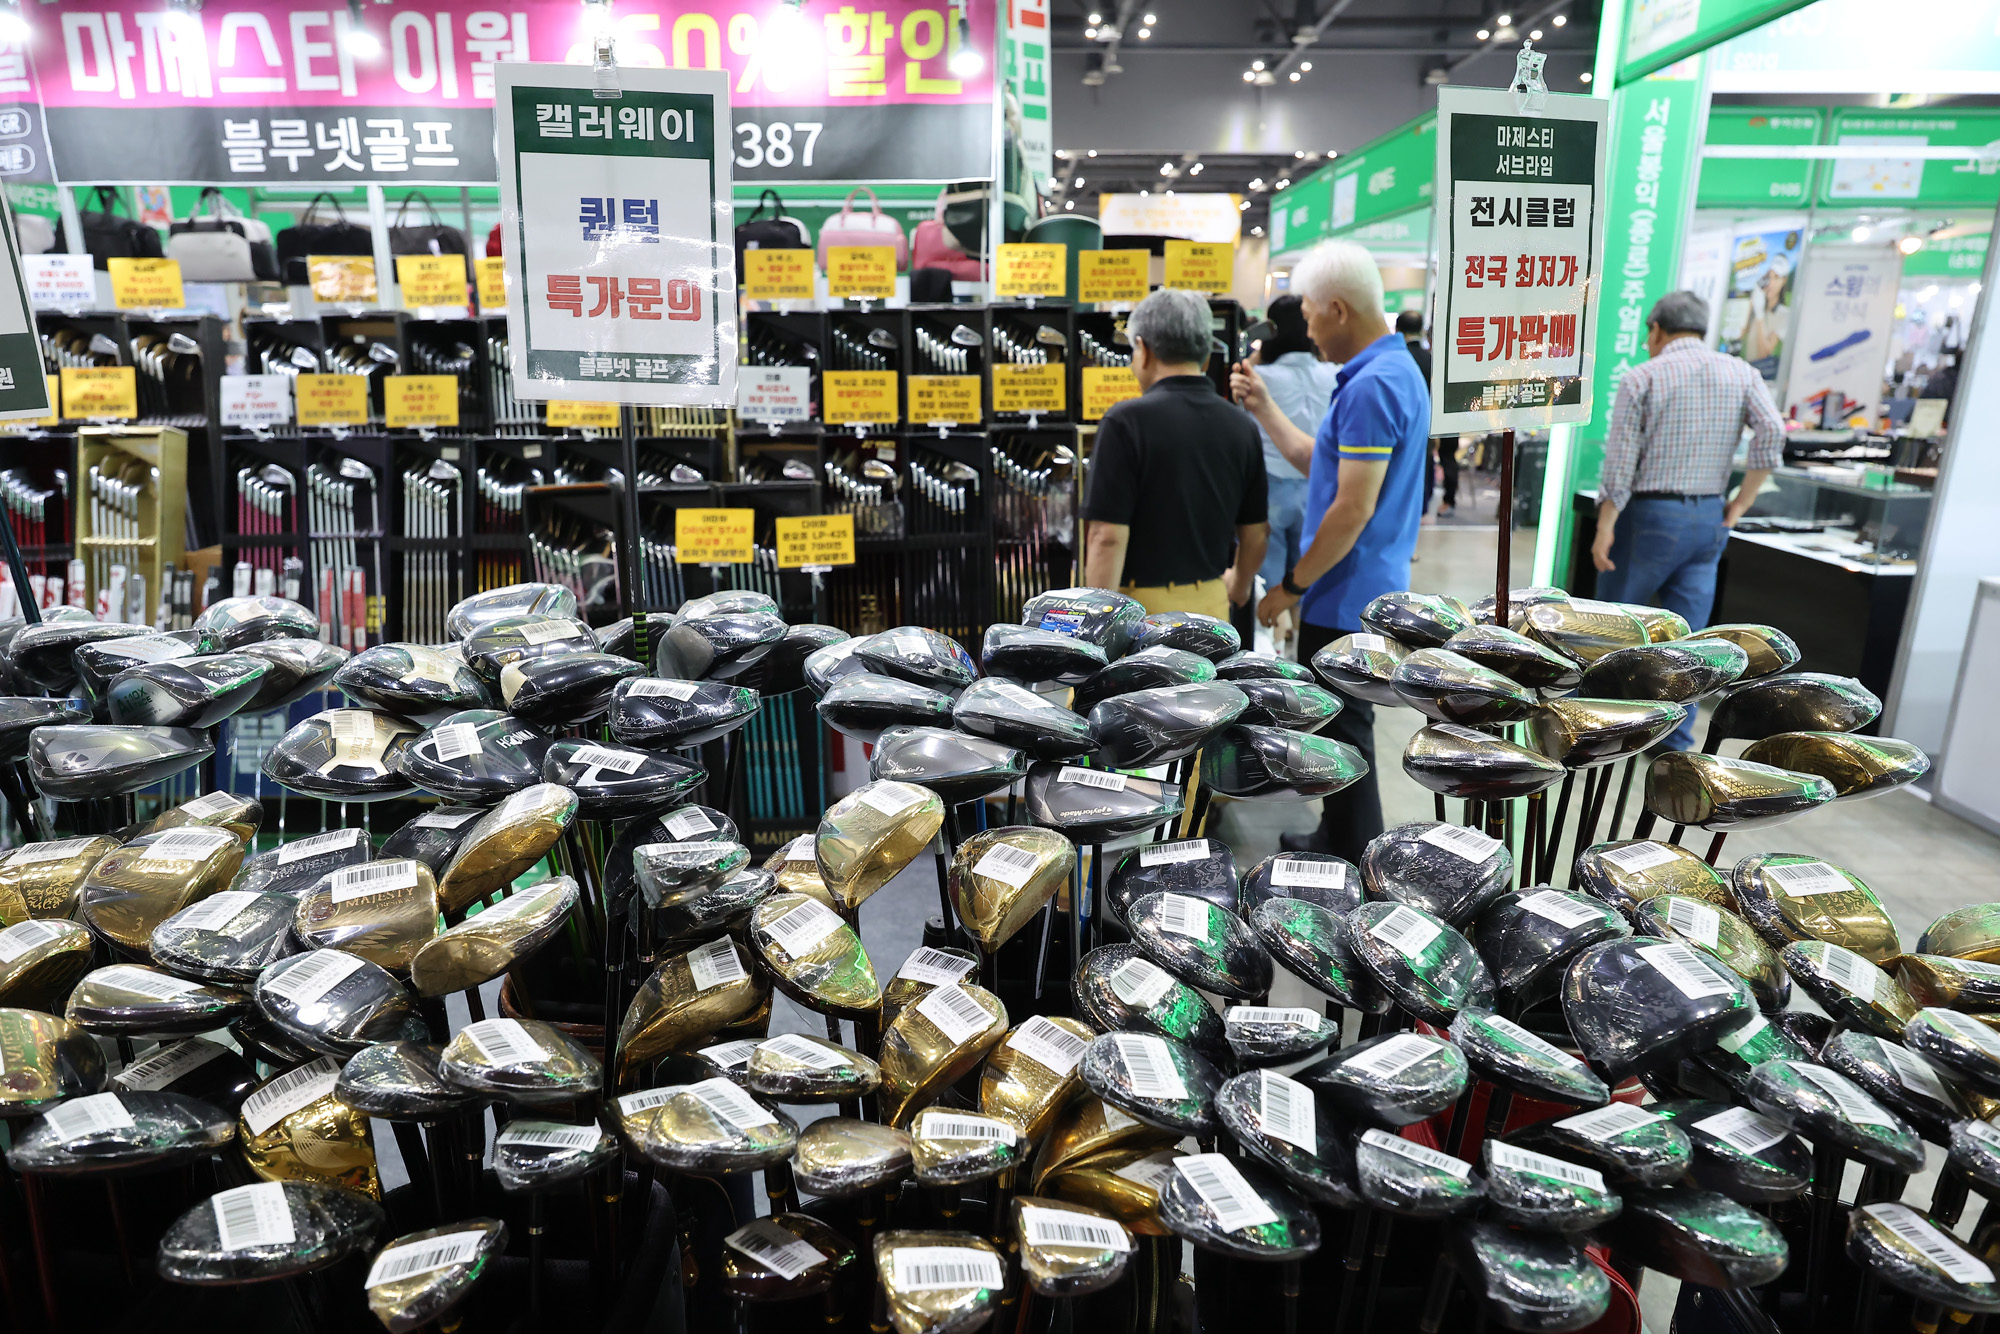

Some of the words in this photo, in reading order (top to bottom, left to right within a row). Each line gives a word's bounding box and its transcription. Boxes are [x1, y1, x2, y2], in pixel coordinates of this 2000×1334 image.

[390, 11, 529, 99] 이월
[824, 6, 963, 97] 할인
[536, 103, 695, 143] 캘러웨이
[221, 116, 460, 173] 블루넷골프
[732, 121, 823, 169] 387
[1496, 125, 1555, 149] 마제스티
[1496, 154, 1554, 177] 서브라임
[1469, 196, 1576, 228] 전시클럽
[1464, 255, 1508, 289] 전국
[1515, 253, 1579, 288] 최저가
[546, 274, 702, 322] 특가문의
[1456, 313, 1577, 363] 특가판매
[578, 356, 631, 379] 블루넷
[634, 358, 670, 380] 골프
[1481, 384, 1518, 407] 블루넷
[1519, 381, 1547, 404] 골프
[682, 525, 714, 535] DRIVE
[718, 525, 747, 535] STAR
[1041, 598, 1089, 610] PING
[1060, 806, 1113, 818] TaylorMade
[126, 859, 196, 875] MAJESTY
[790, 861, 817, 871] MAJE
[345, 887, 415, 908] MAJESTY
[131, 917, 144, 932] 3
